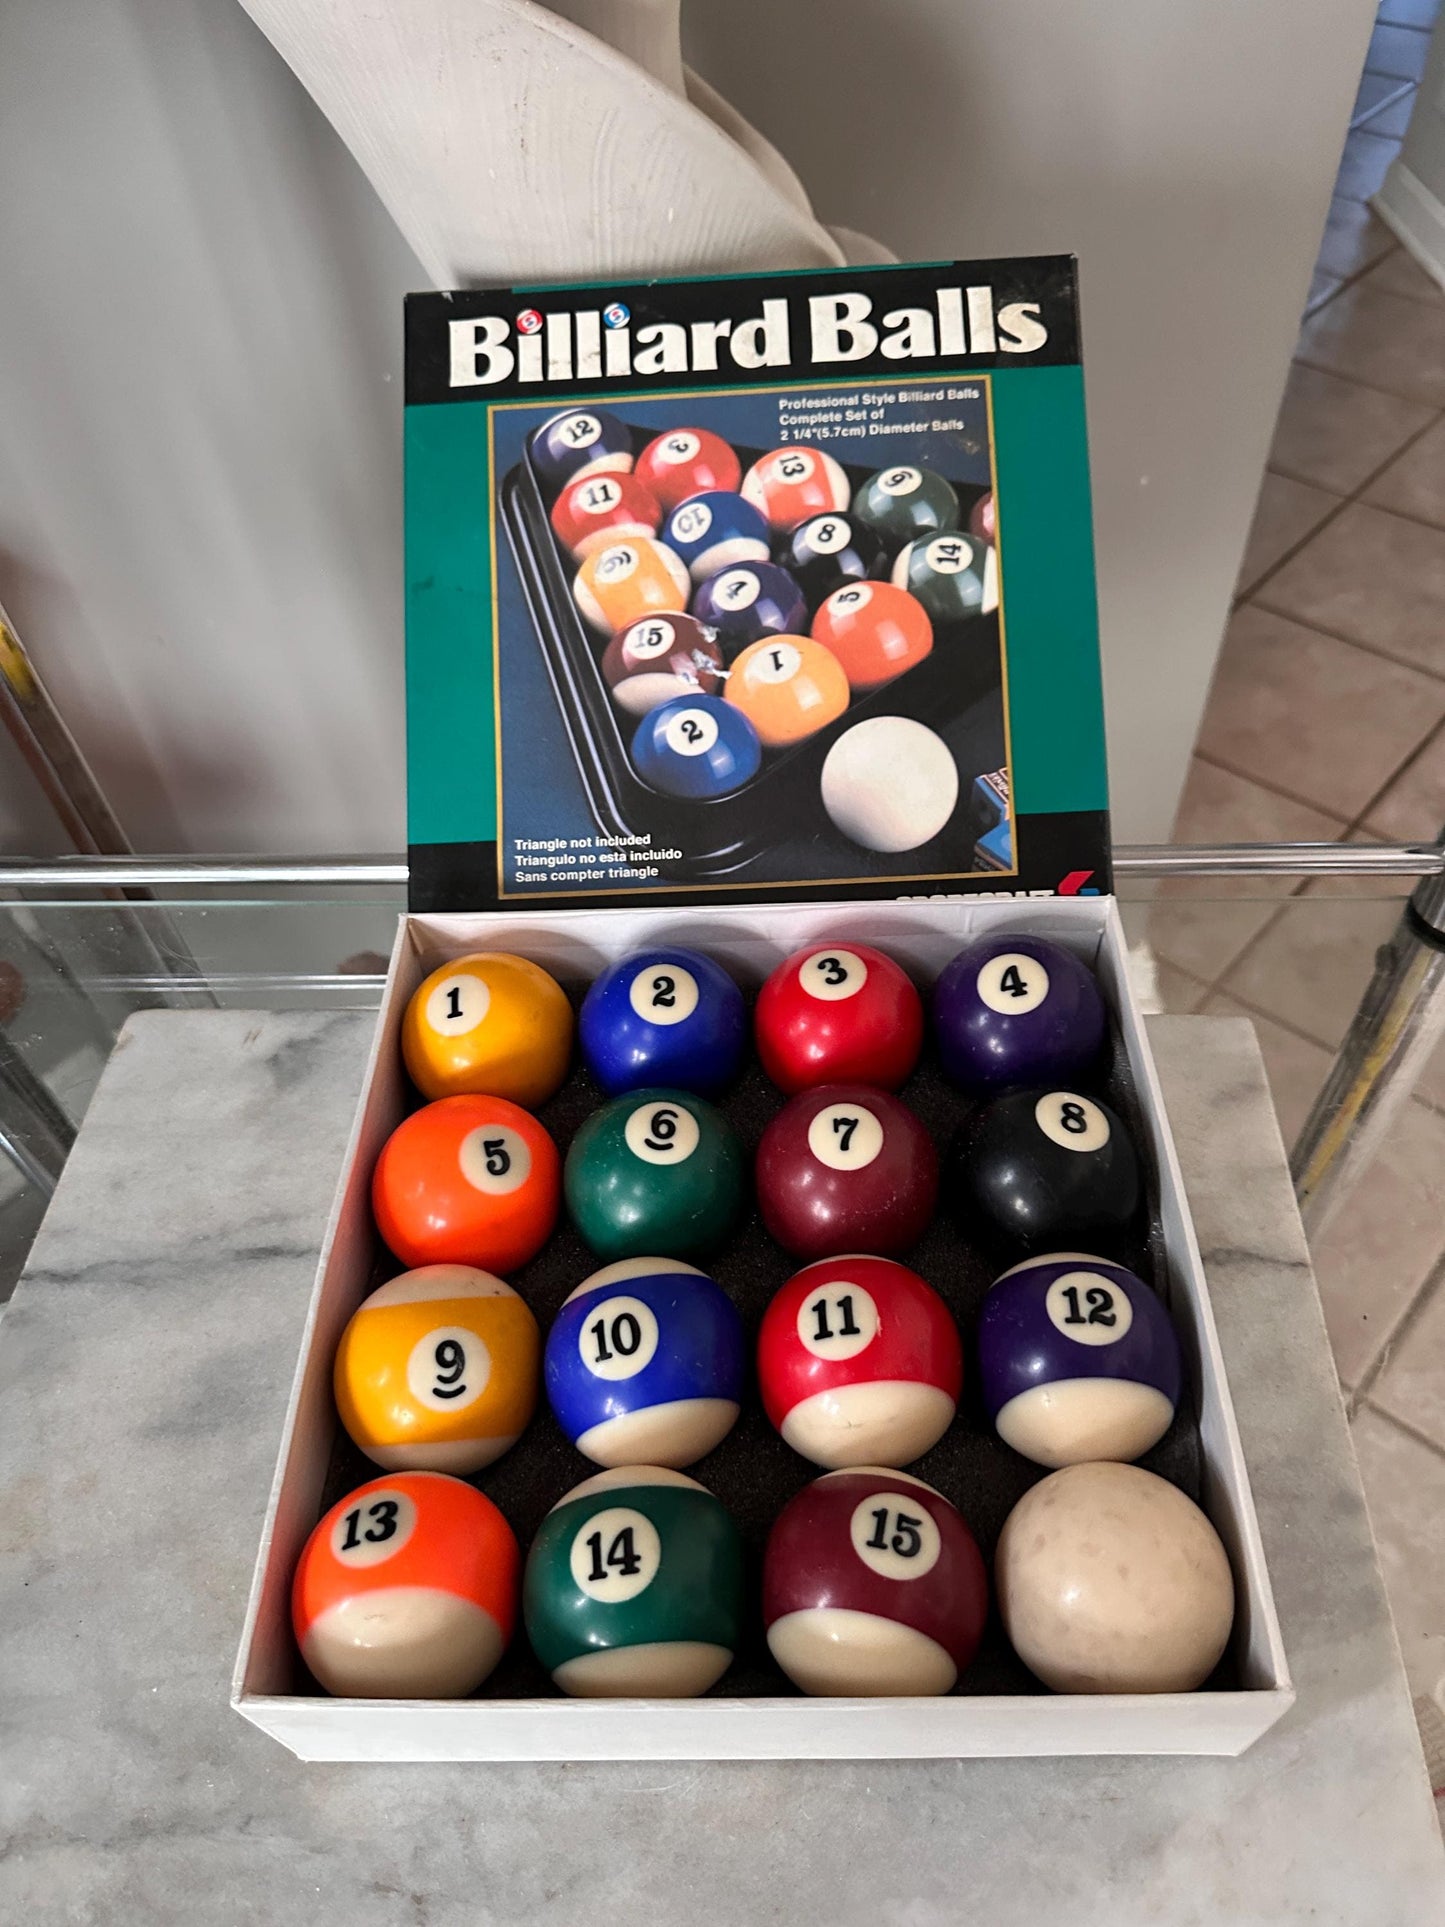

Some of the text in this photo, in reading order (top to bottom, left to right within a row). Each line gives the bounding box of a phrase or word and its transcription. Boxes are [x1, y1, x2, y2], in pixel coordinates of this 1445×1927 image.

[448, 285, 1049, 388] Billiard Balls
[779, 388, 980, 410] Professional Style Billiard Balls
[779, 408, 885, 425] Complete Set of
[566, 420, 594, 443] 12
[780, 431, 789, 441] 2
[869, 422, 928, 435] Diameter
[932, 419, 964, 431] Balls
[668, 438, 689, 453] 3
[780, 455, 805, 477] 13
[587, 484, 613, 507] 11
[818, 524, 836, 543] 8
[936, 543, 962, 566] 14
[725, 580, 748, 600] 4
[837, 591, 860, 604] 5
[634, 627, 663, 649] 15
[769, 650, 784, 671] 1
[681, 720, 704, 743] 2
[514, 833, 651, 852] Triangle not included
[514, 849, 683, 867] Triangulo no esta incluido
[515, 866, 659, 882] Sans compter triangle
[816, 957, 848, 985] 3
[999, 964, 1028, 997] 4
[446, 986, 463, 1019] 1
[651, 975, 676, 1007] 2
[650, 1109, 679, 1139] 6
[1061, 1102, 1087, 1133] 8
[832, 1117, 859, 1151] 7
[483, 1138, 511, 1176] 5
[811, 1295, 861, 1341] 11
[1061, 1286, 1117, 1327] 12
[591, 1312, 641, 1363] 10
[434, 1339, 466, 1384] 9
[341, 1500, 399, 1551] 13
[866, 1507, 922, 1558] 15
[586, 1526, 641, 1581] 14
